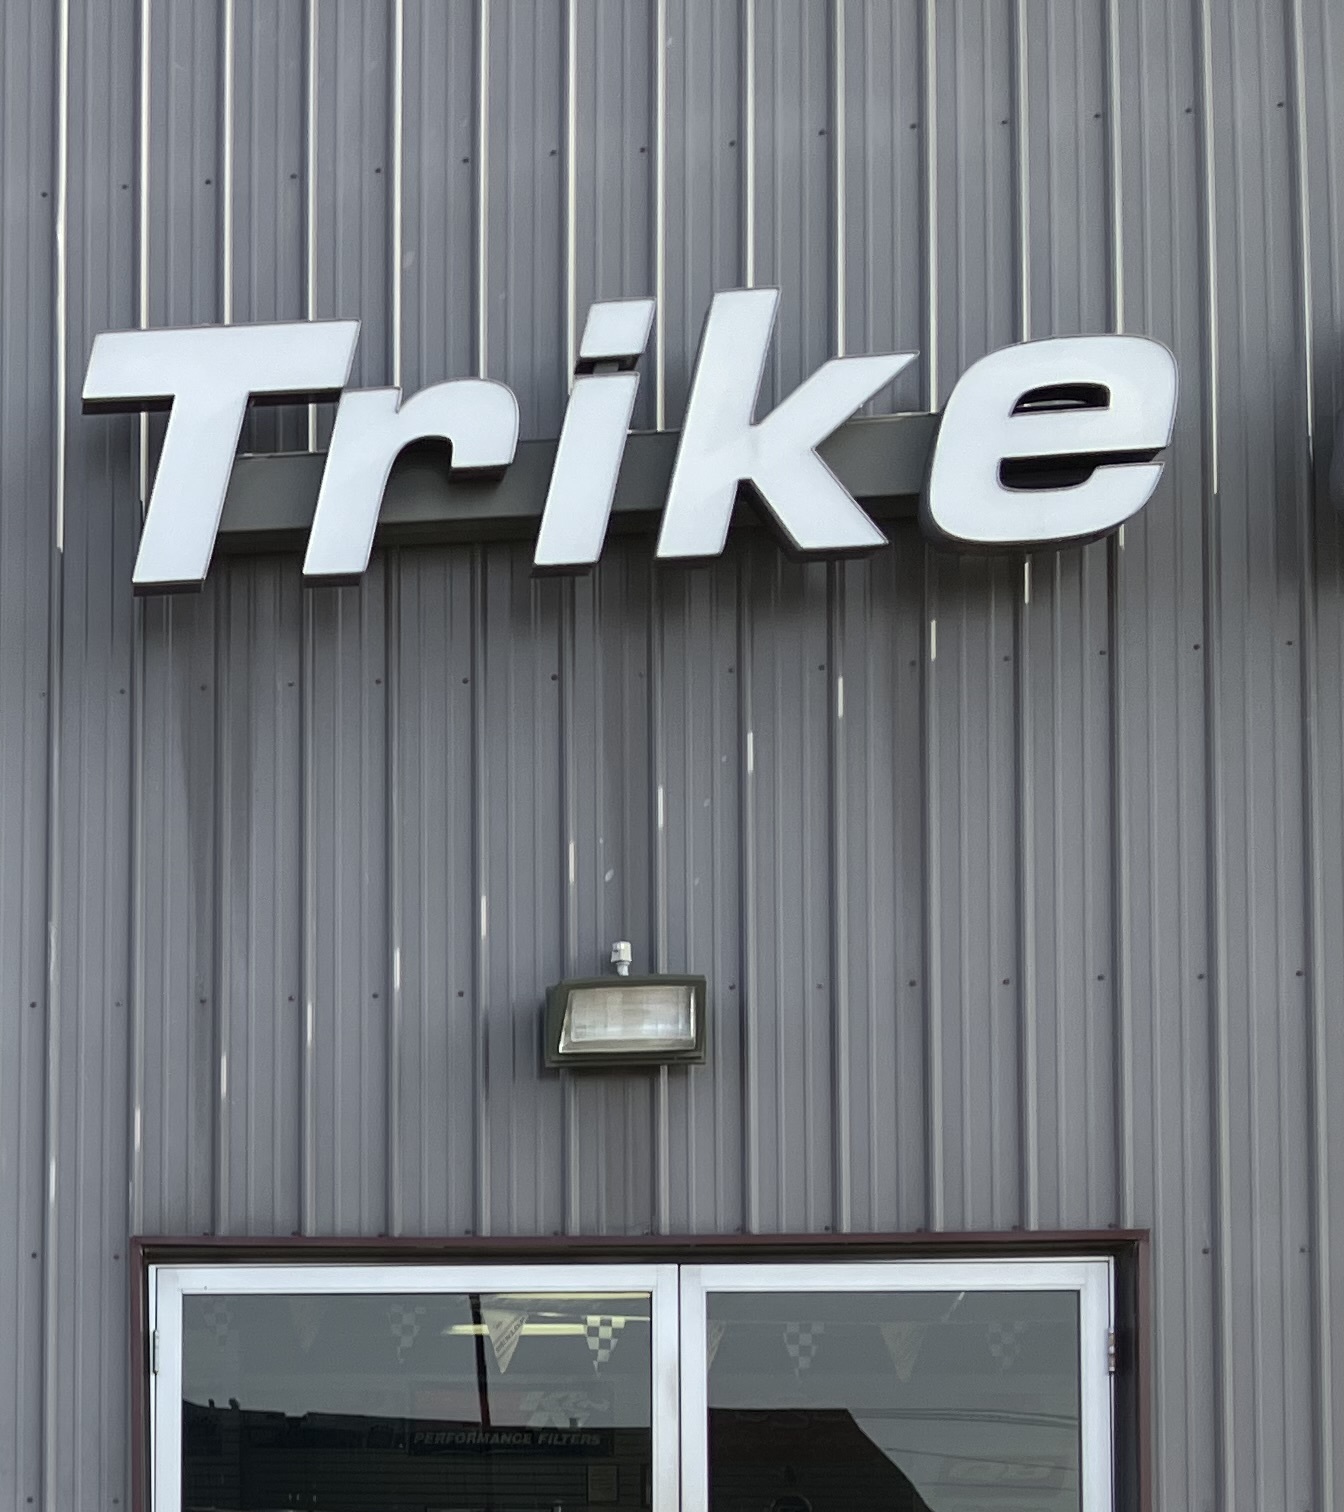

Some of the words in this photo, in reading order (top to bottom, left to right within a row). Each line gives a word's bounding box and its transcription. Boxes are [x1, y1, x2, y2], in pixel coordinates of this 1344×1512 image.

[82, 287, 1179, 595] Trike
[413, 1430, 534, 1446] PERFORMANCE
[537, 1431, 602, 1447] FILTERS
